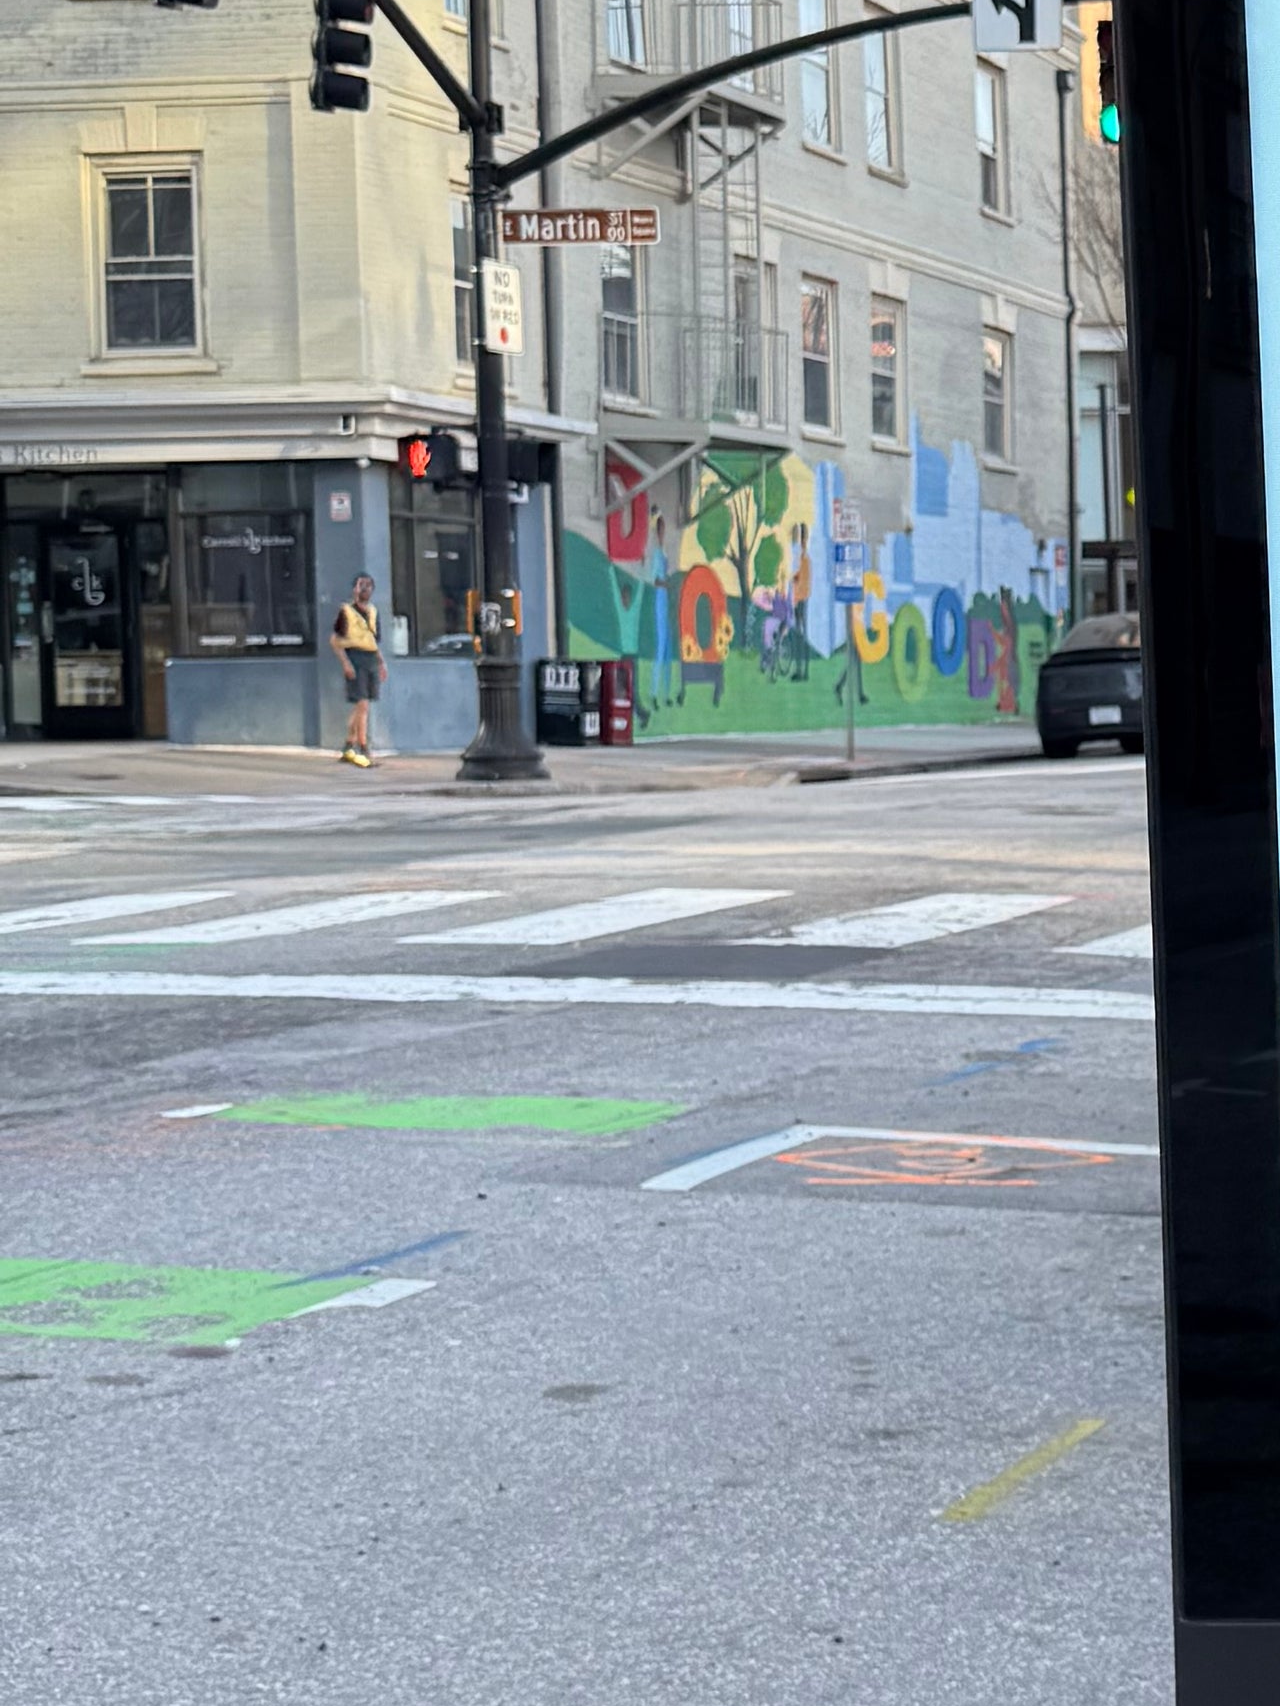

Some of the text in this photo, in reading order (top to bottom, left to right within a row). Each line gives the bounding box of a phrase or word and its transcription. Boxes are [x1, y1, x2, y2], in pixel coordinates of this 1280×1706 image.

[519, 212, 600, 242] Martin
[494, 270, 511, 289] NO
[15, 443, 99, 464] Kitchen
